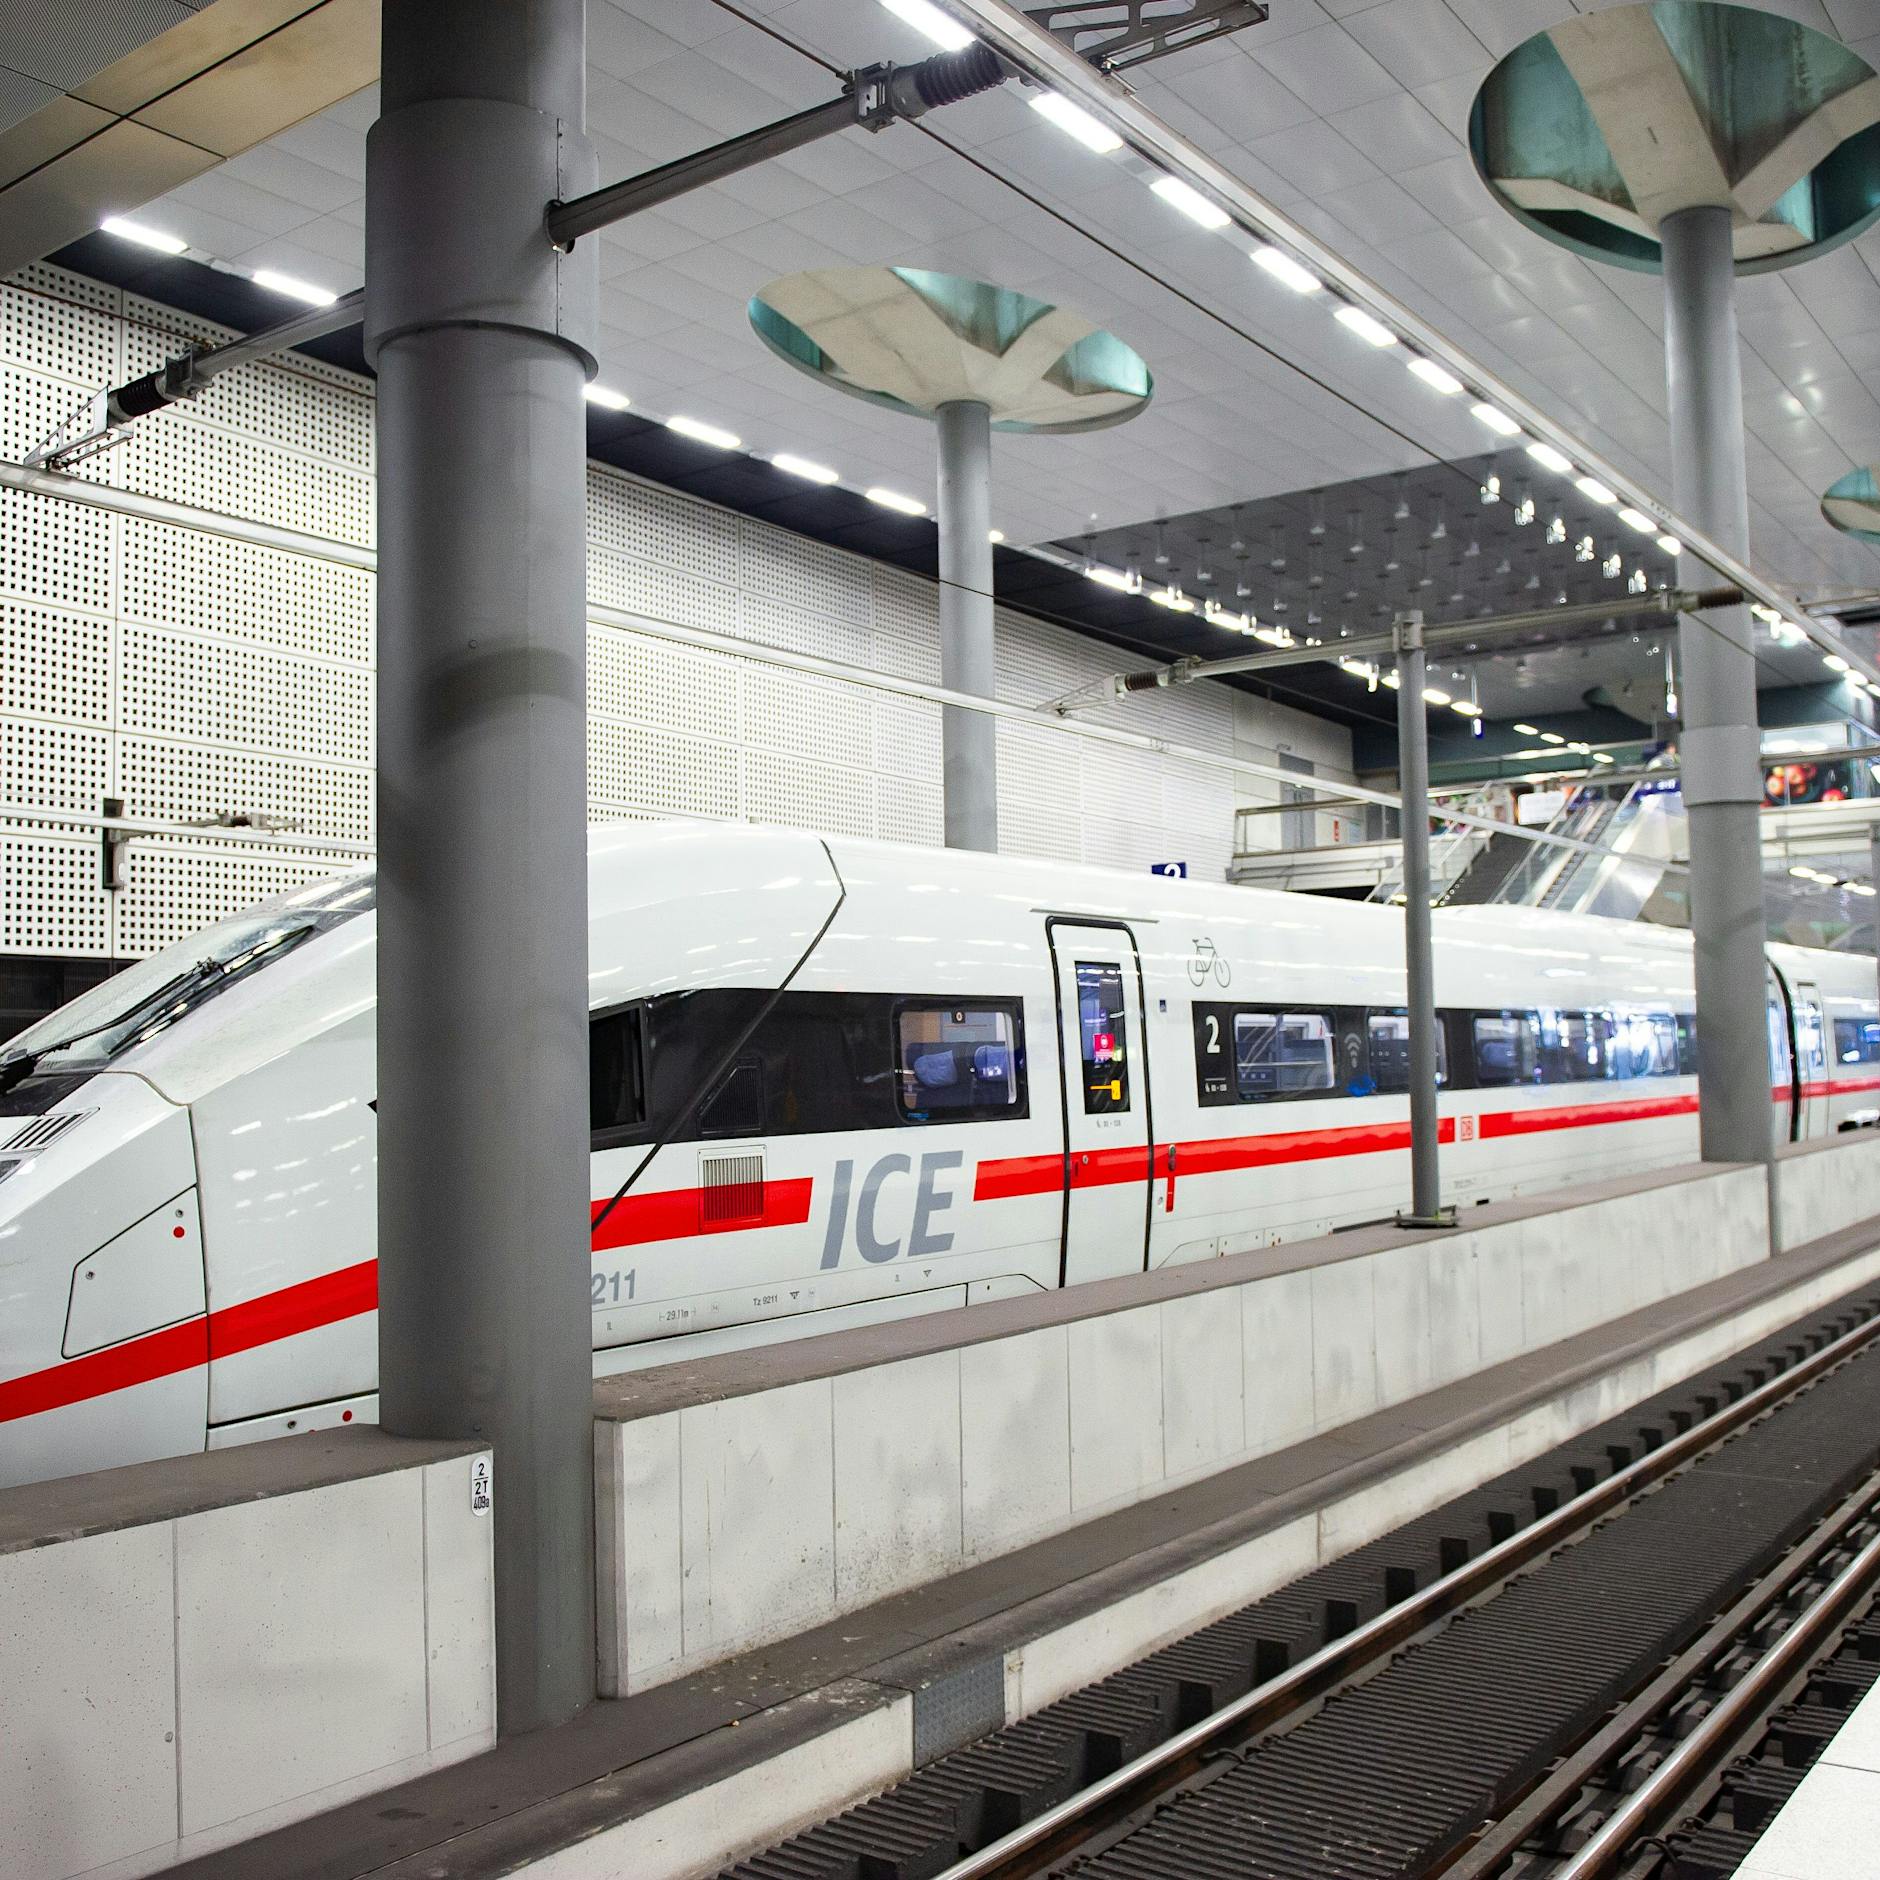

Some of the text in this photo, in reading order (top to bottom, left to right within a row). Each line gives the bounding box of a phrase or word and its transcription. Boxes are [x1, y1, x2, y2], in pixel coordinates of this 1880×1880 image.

[1205, 1015, 1220, 1054] 2
[820, 1150, 963, 1270] ICE
[478, 1463, 485, 1476] 2
[474, 1496, 490, 1510] 409a
